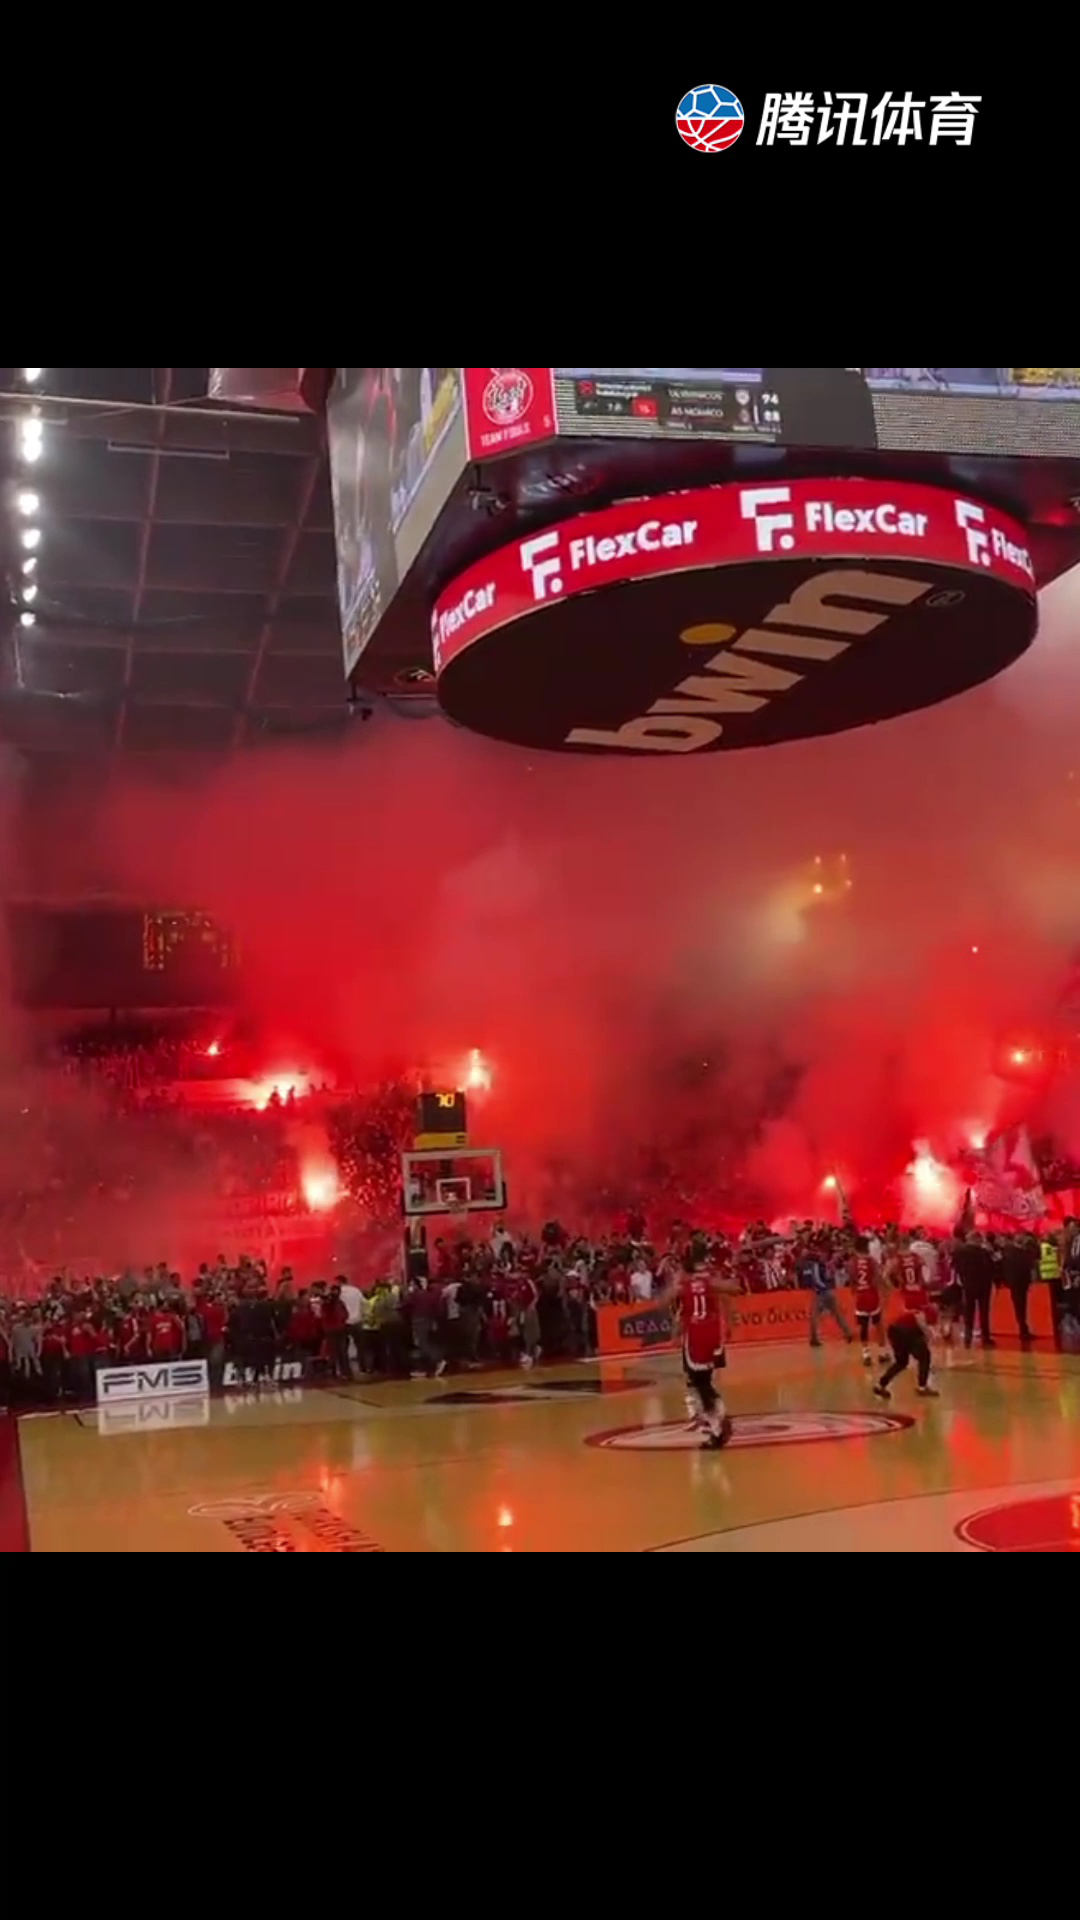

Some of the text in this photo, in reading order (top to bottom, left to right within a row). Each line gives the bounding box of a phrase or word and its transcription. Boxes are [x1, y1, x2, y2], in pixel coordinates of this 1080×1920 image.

[805, 501, 928, 537] FlexCar
[569, 520, 698, 571] FlexCar
[564, 569, 936, 753] bwin
[693, 1295, 707, 1320] 11
[103, 1365, 203, 1394] FMS
